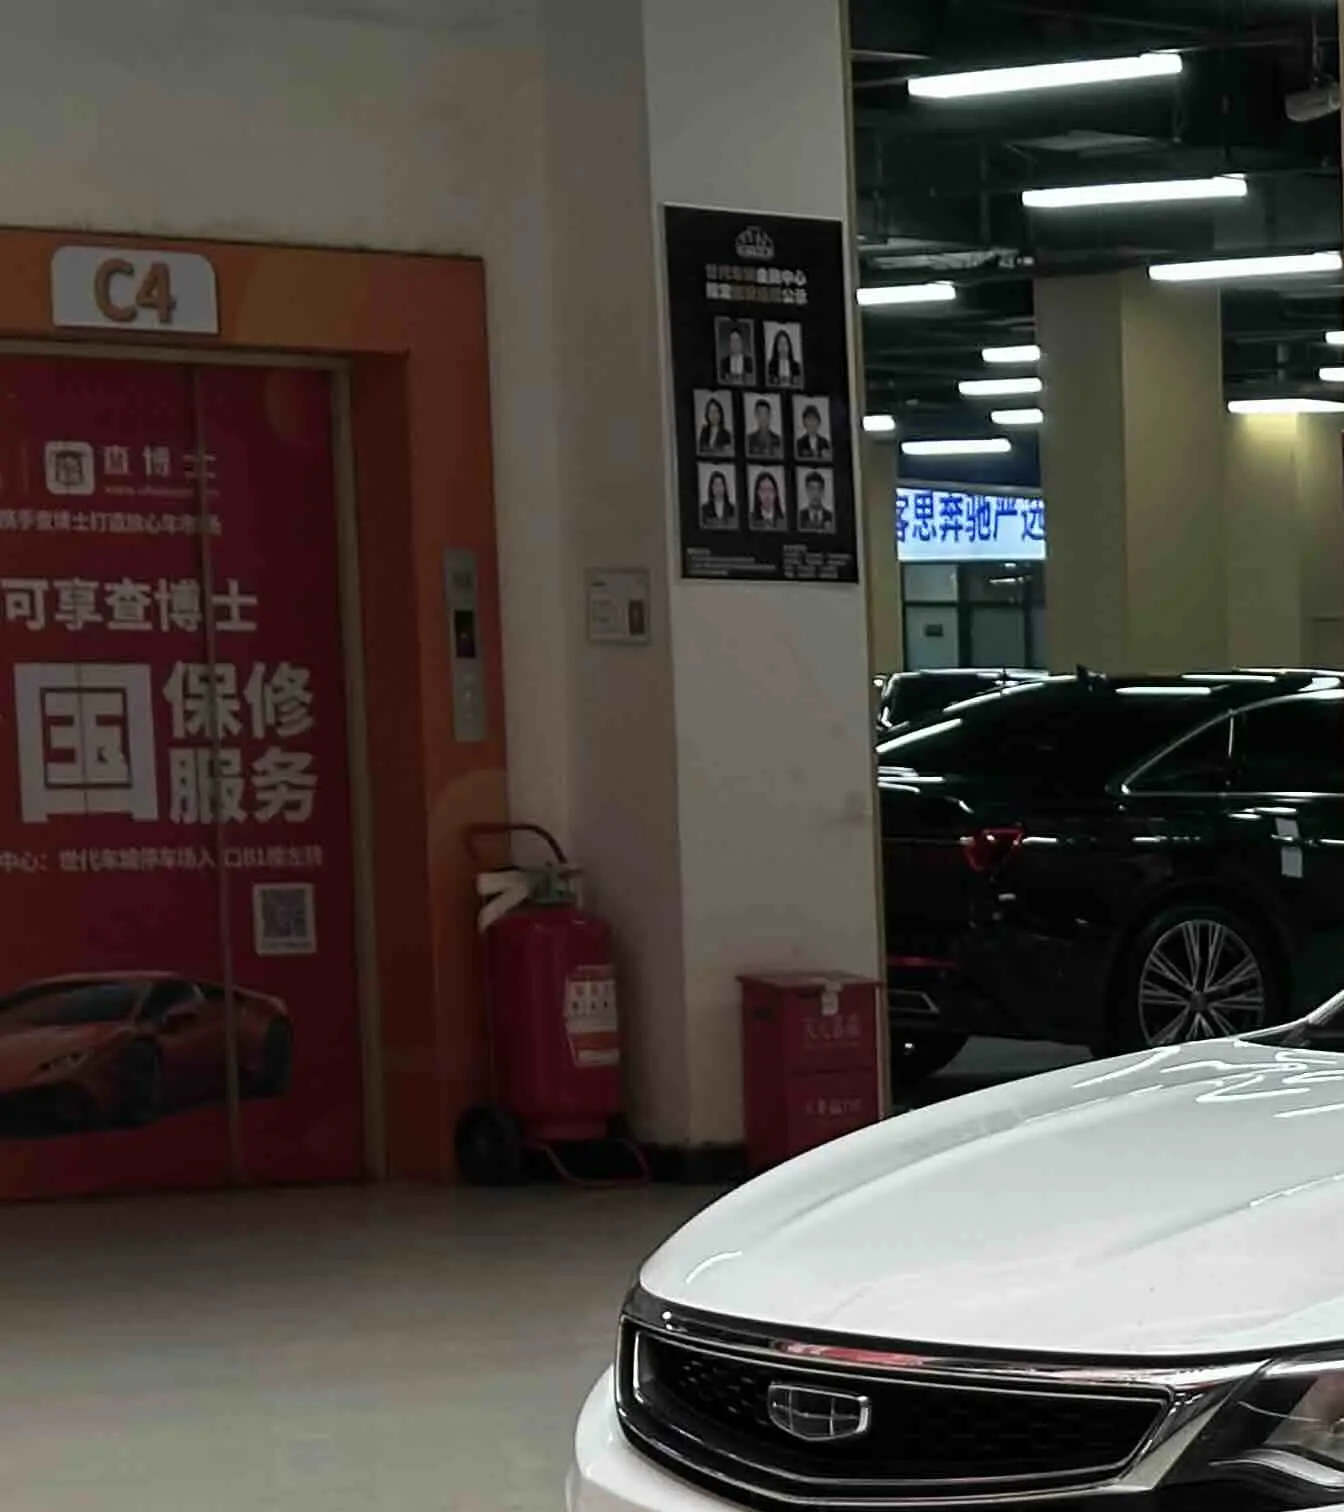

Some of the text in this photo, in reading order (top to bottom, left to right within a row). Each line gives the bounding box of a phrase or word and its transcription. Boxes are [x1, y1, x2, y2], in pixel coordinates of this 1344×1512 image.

[94, 258, 177, 325] C4
[0, 576, 259, 633] 可享查博士
[162, 659, 316, 740] 保修
[167, 745, 320, 824] 服务
